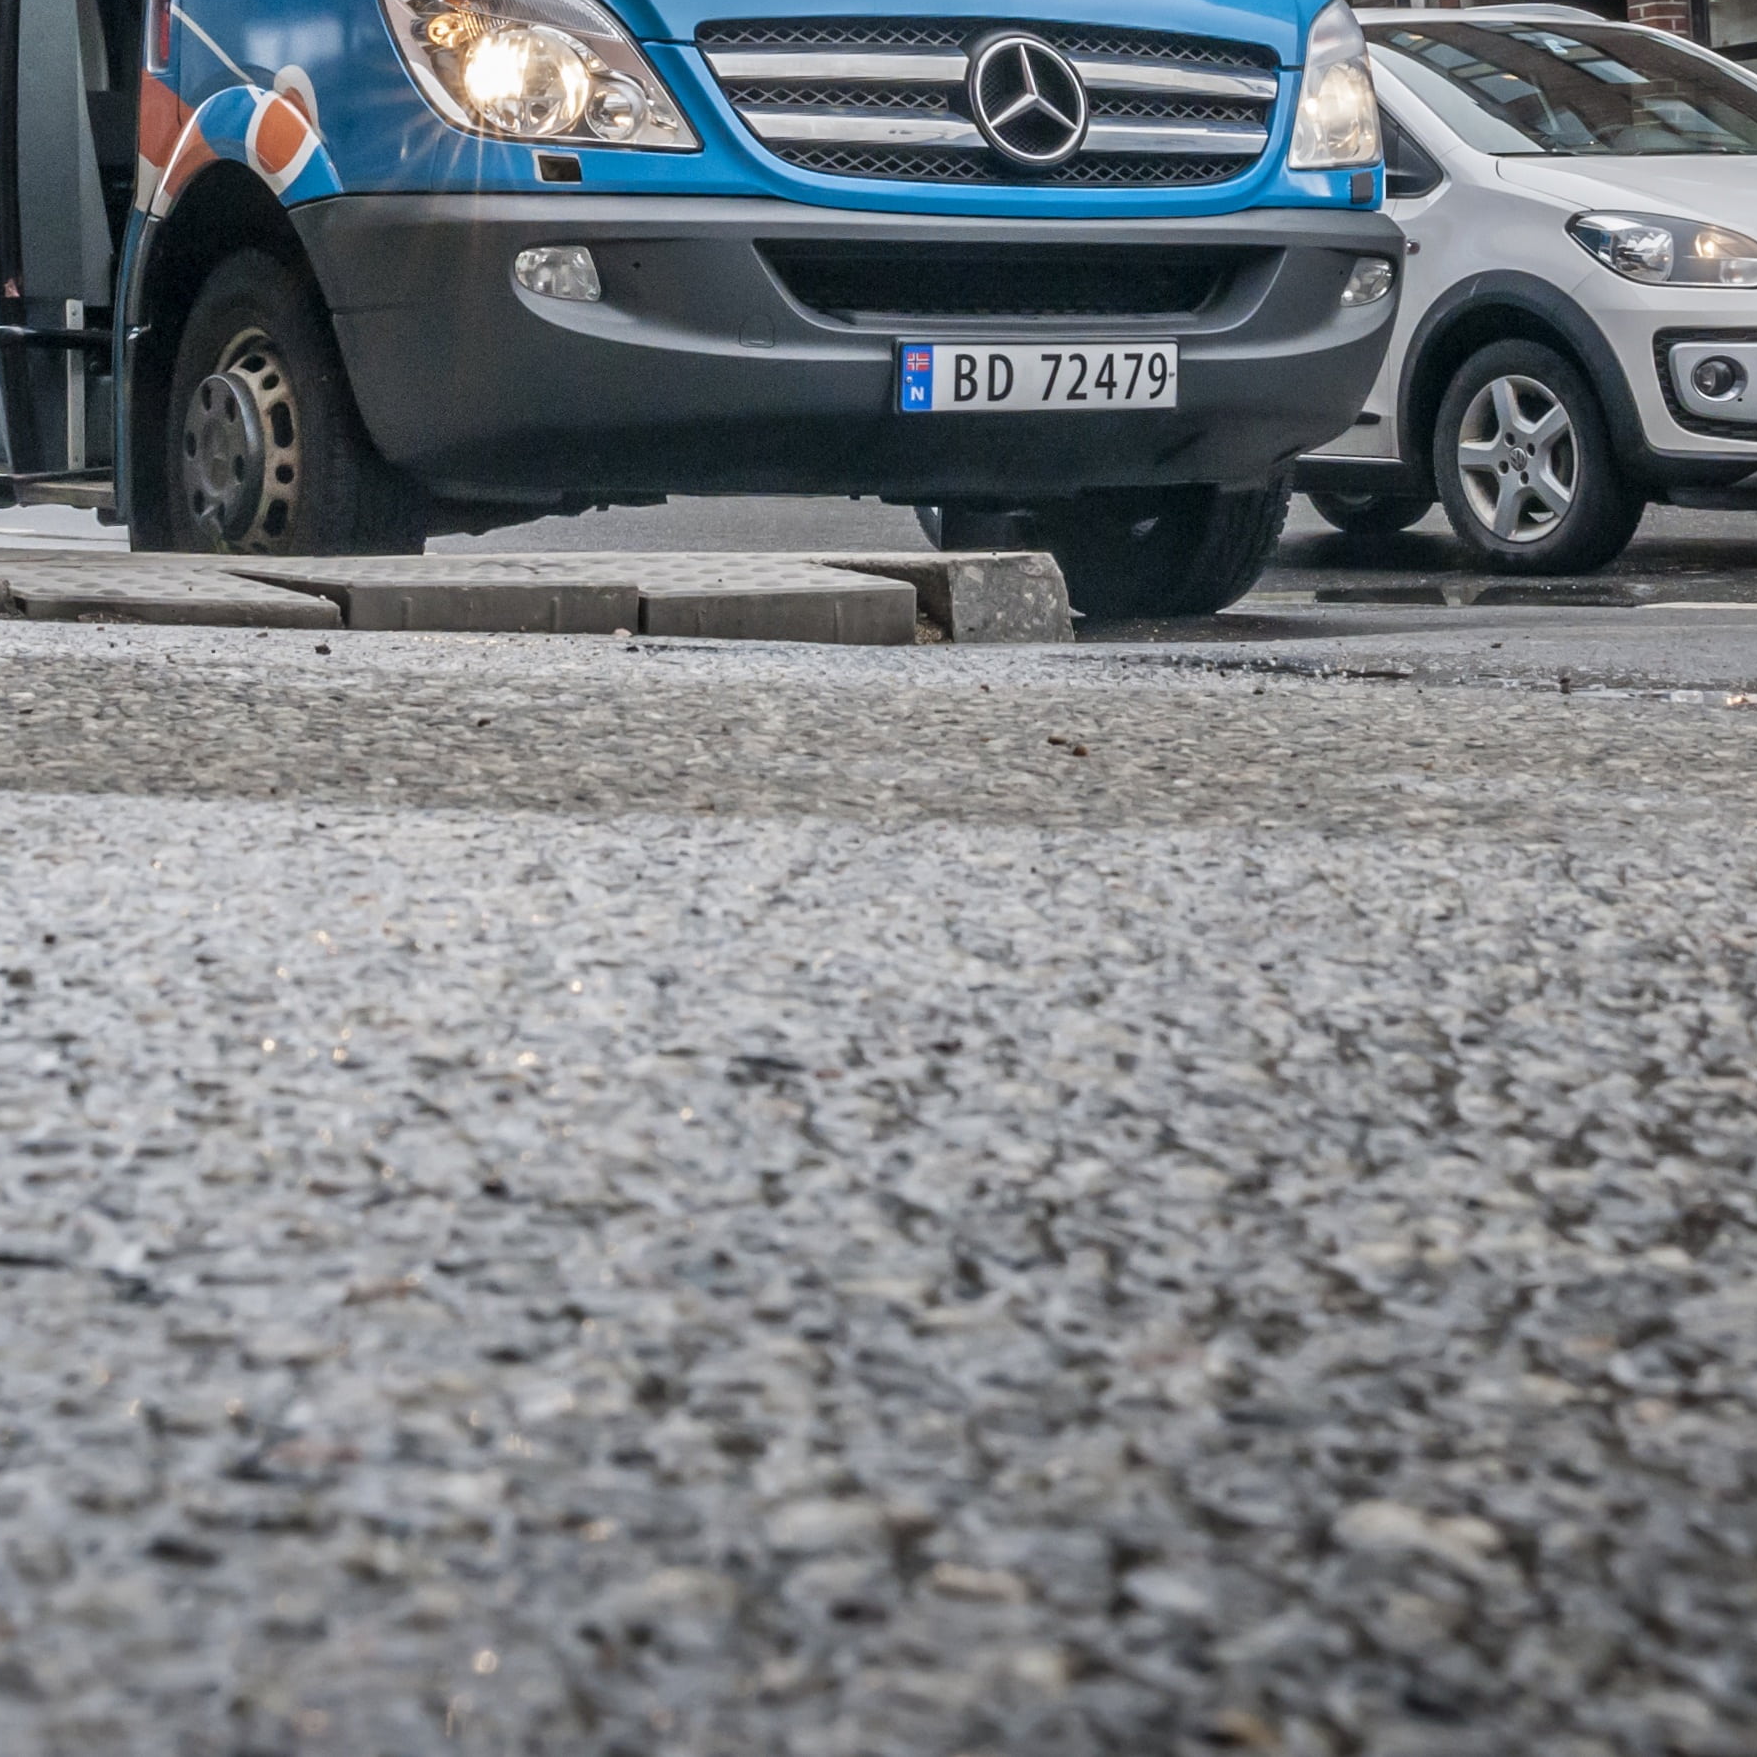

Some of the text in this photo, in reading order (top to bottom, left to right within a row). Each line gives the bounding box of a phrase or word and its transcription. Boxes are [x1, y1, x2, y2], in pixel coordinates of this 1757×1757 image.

[953, 352, 1168, 402] BD 72479
[910, 386, 924, 401] N
